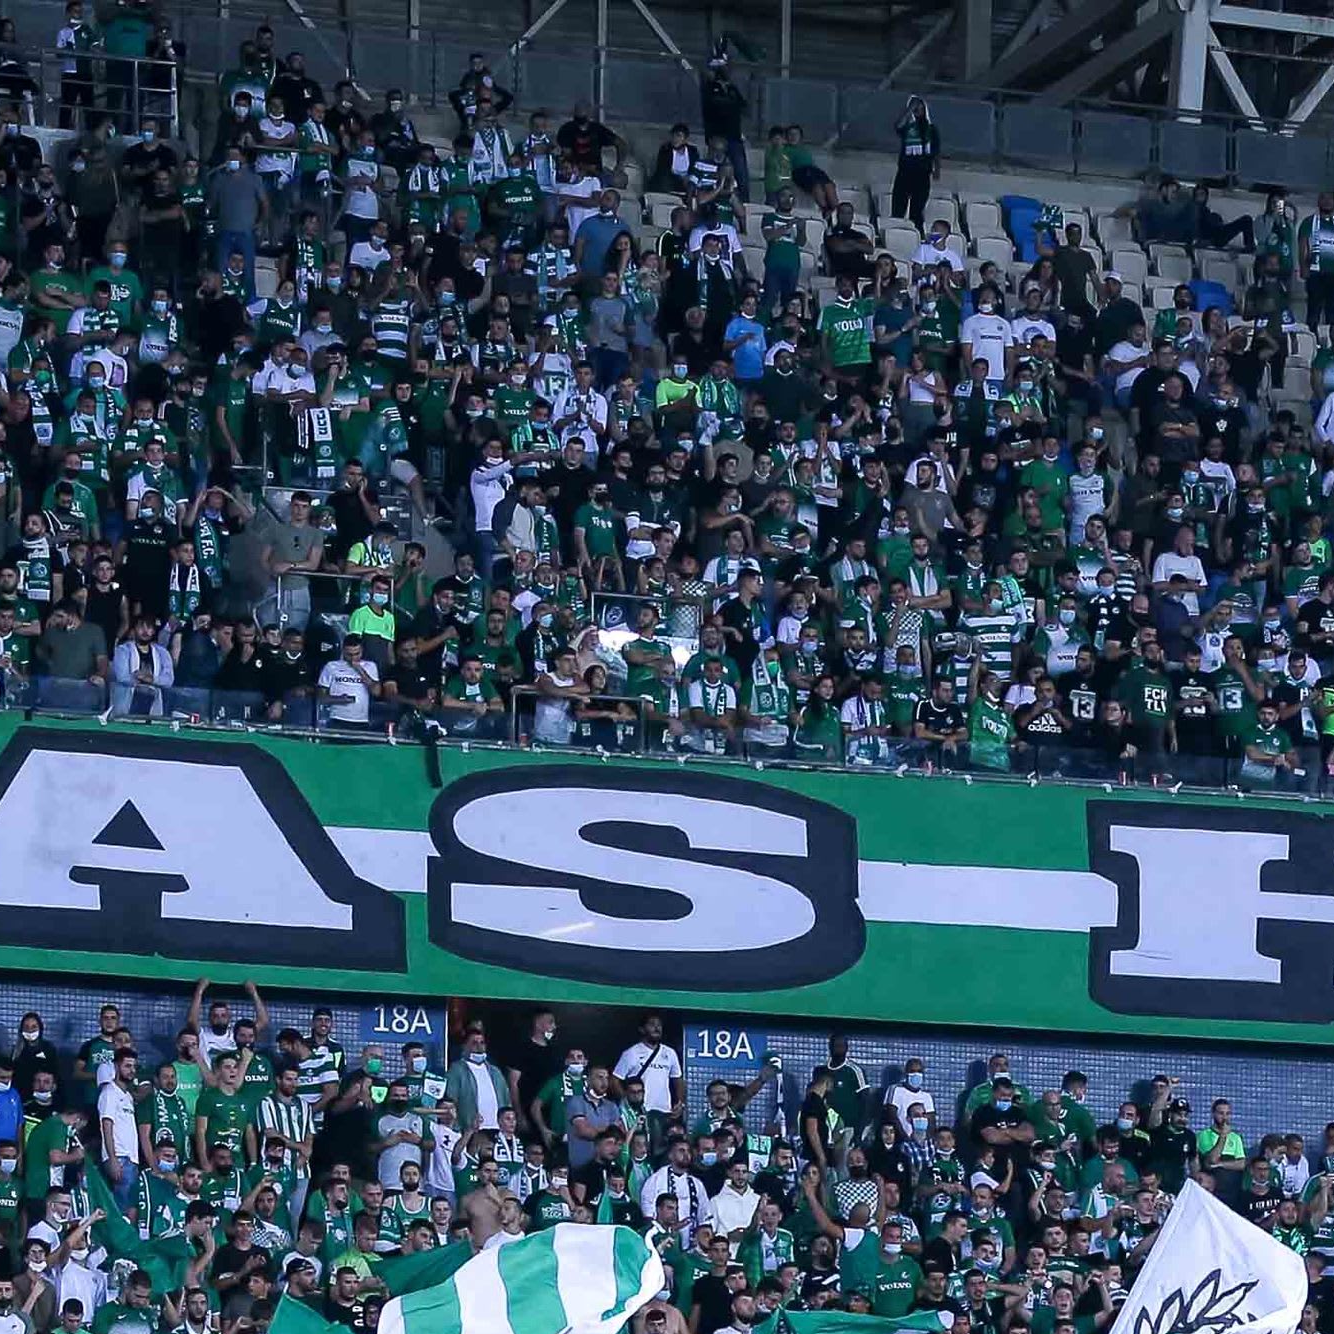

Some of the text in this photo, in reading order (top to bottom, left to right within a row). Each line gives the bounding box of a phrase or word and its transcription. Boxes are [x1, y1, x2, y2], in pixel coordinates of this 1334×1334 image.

[1071, 698, 1094, 720] 13
[1028, 723, 1063, 735] adidas
[371, 1003, 433, 1035] 18A
[696, 1029, 756, 1062] 18A
[879, 1281, 913, 1291] VOLVO
